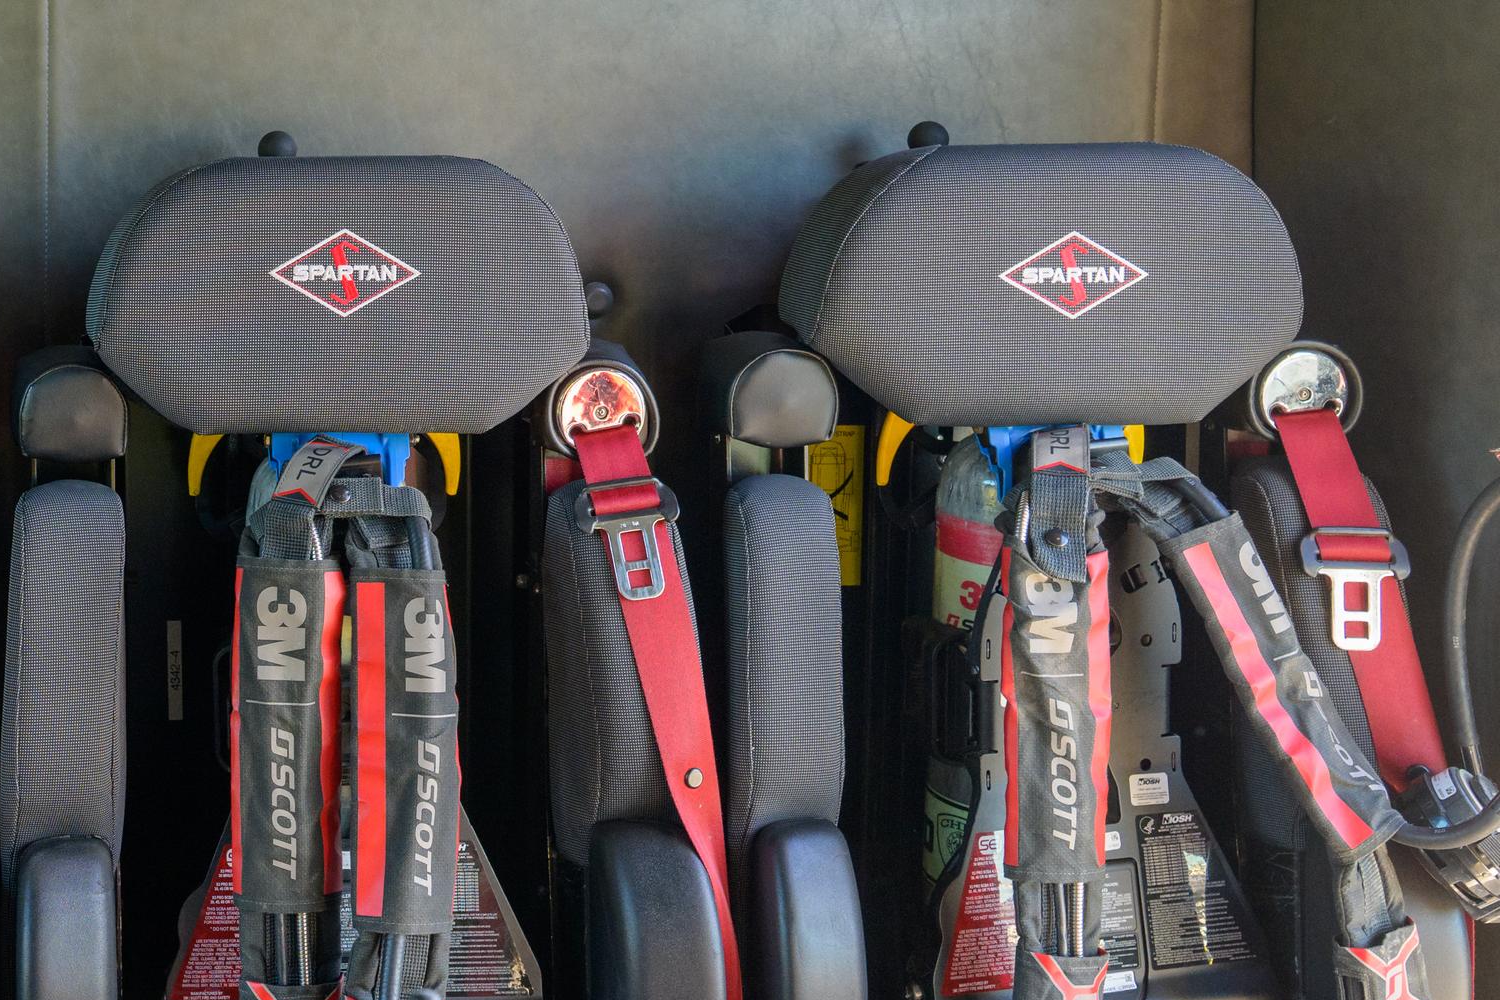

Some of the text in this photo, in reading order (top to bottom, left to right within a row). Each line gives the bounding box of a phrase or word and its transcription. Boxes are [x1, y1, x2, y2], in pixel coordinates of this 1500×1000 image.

[292, 265, 398, 282] SPARTAN
[1022, 266, 1125, 284] SPARTAN
[1050, 429, 1070, 455] DRL
[296, 447, 332, 481] DRL
[1025, 572, 1078, 851] 3M SCOTT
[256, 586, 308, 881] 3M SCOTT
[403, 597, 447, 897] 3M SCOTT
[1162, 813, 1193, 825] NIOSH
